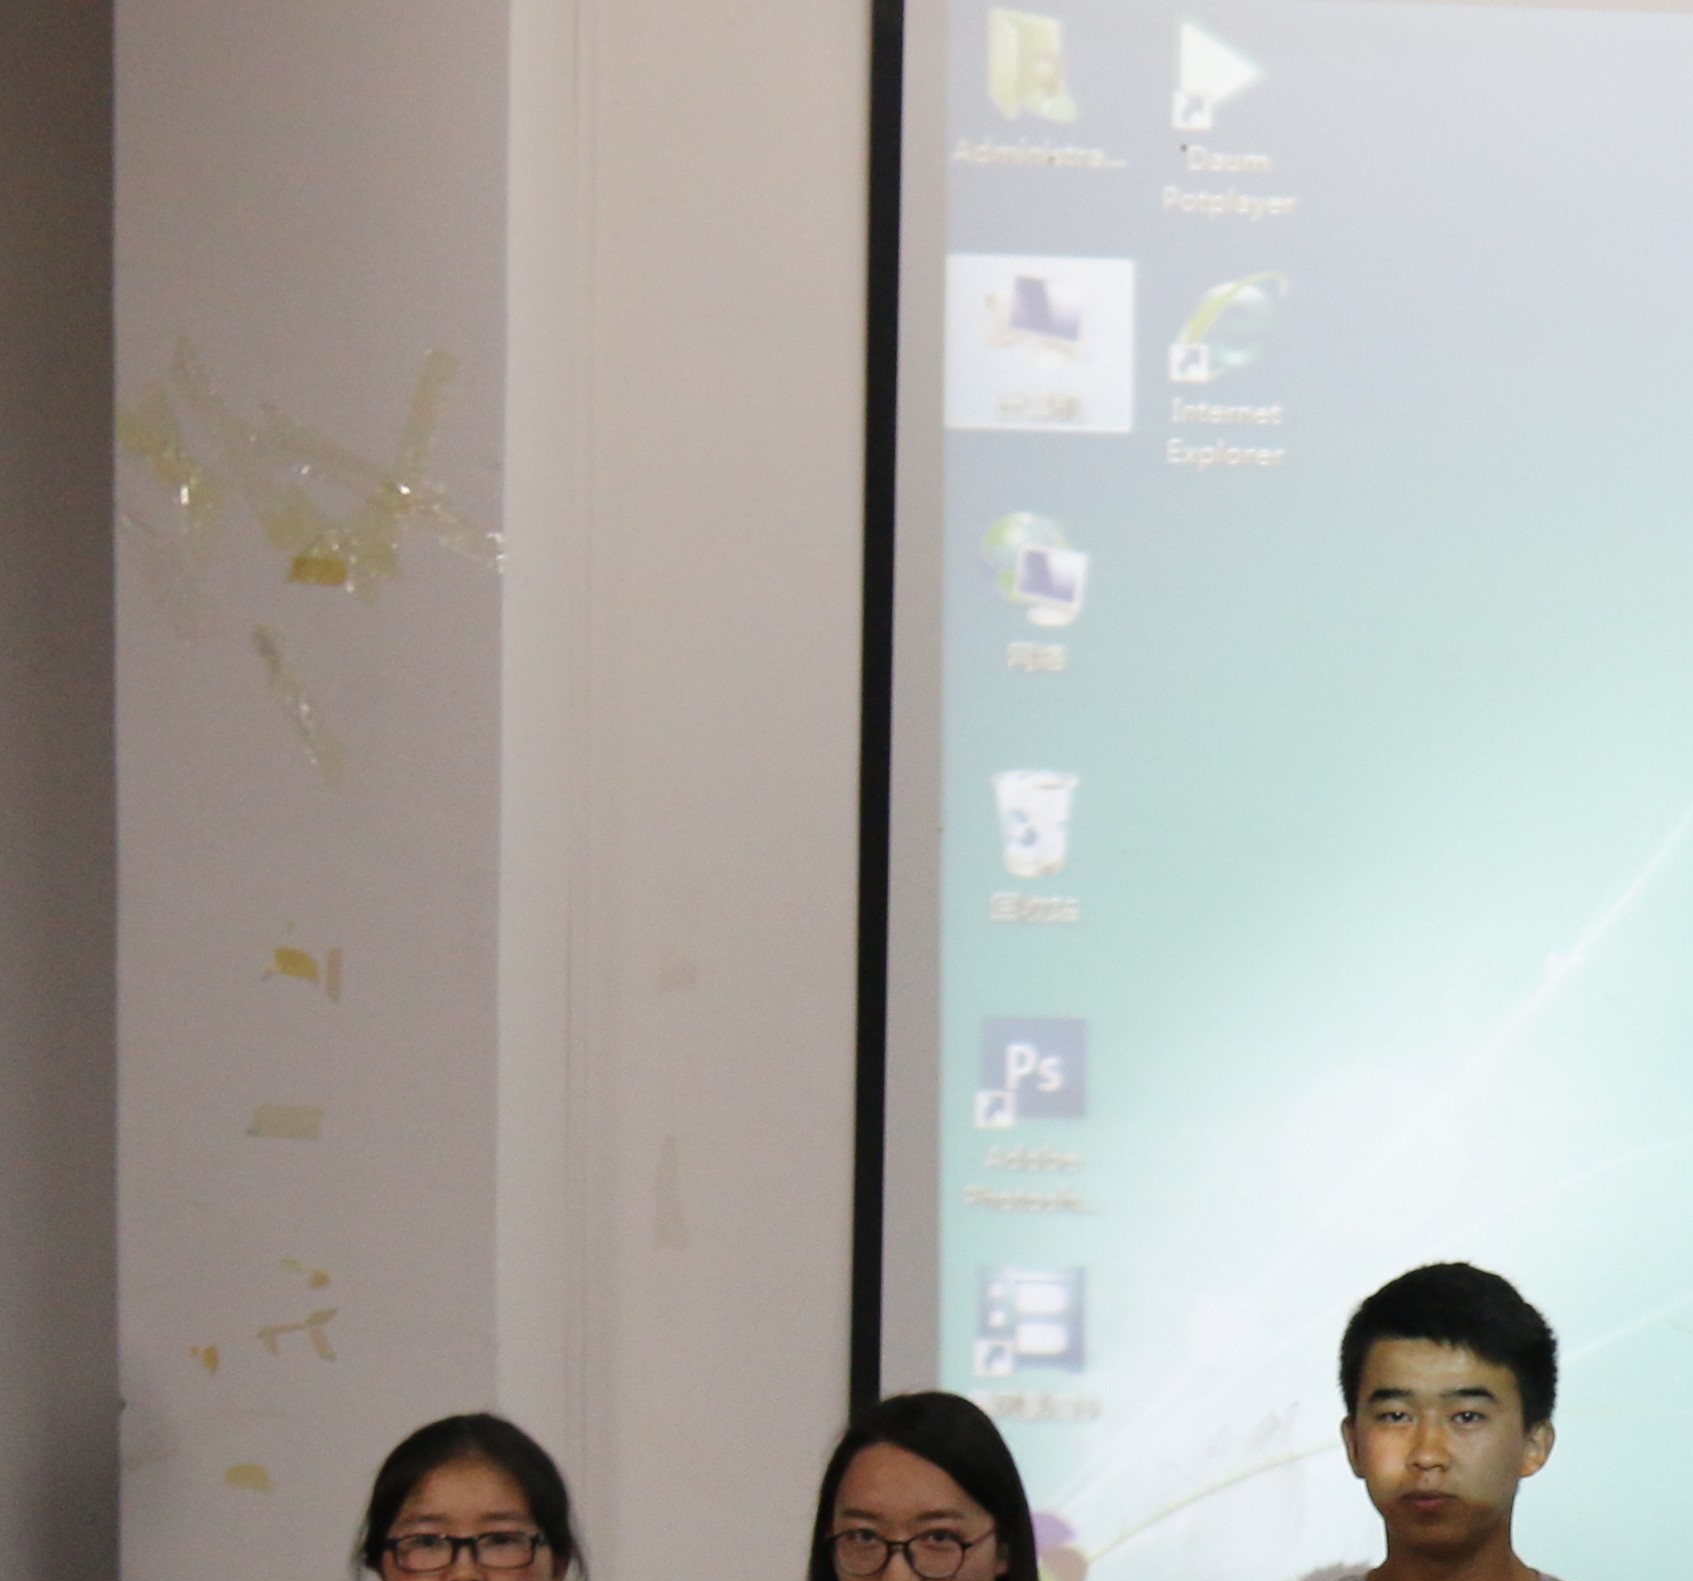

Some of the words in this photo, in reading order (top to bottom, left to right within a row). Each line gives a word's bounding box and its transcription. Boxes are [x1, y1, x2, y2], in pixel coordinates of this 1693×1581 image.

[1171, 398, 1282, 425] Internet
[1167, 438, 1285, 472] Explorer
[1005, 1043, 1063, 1093] Ps
